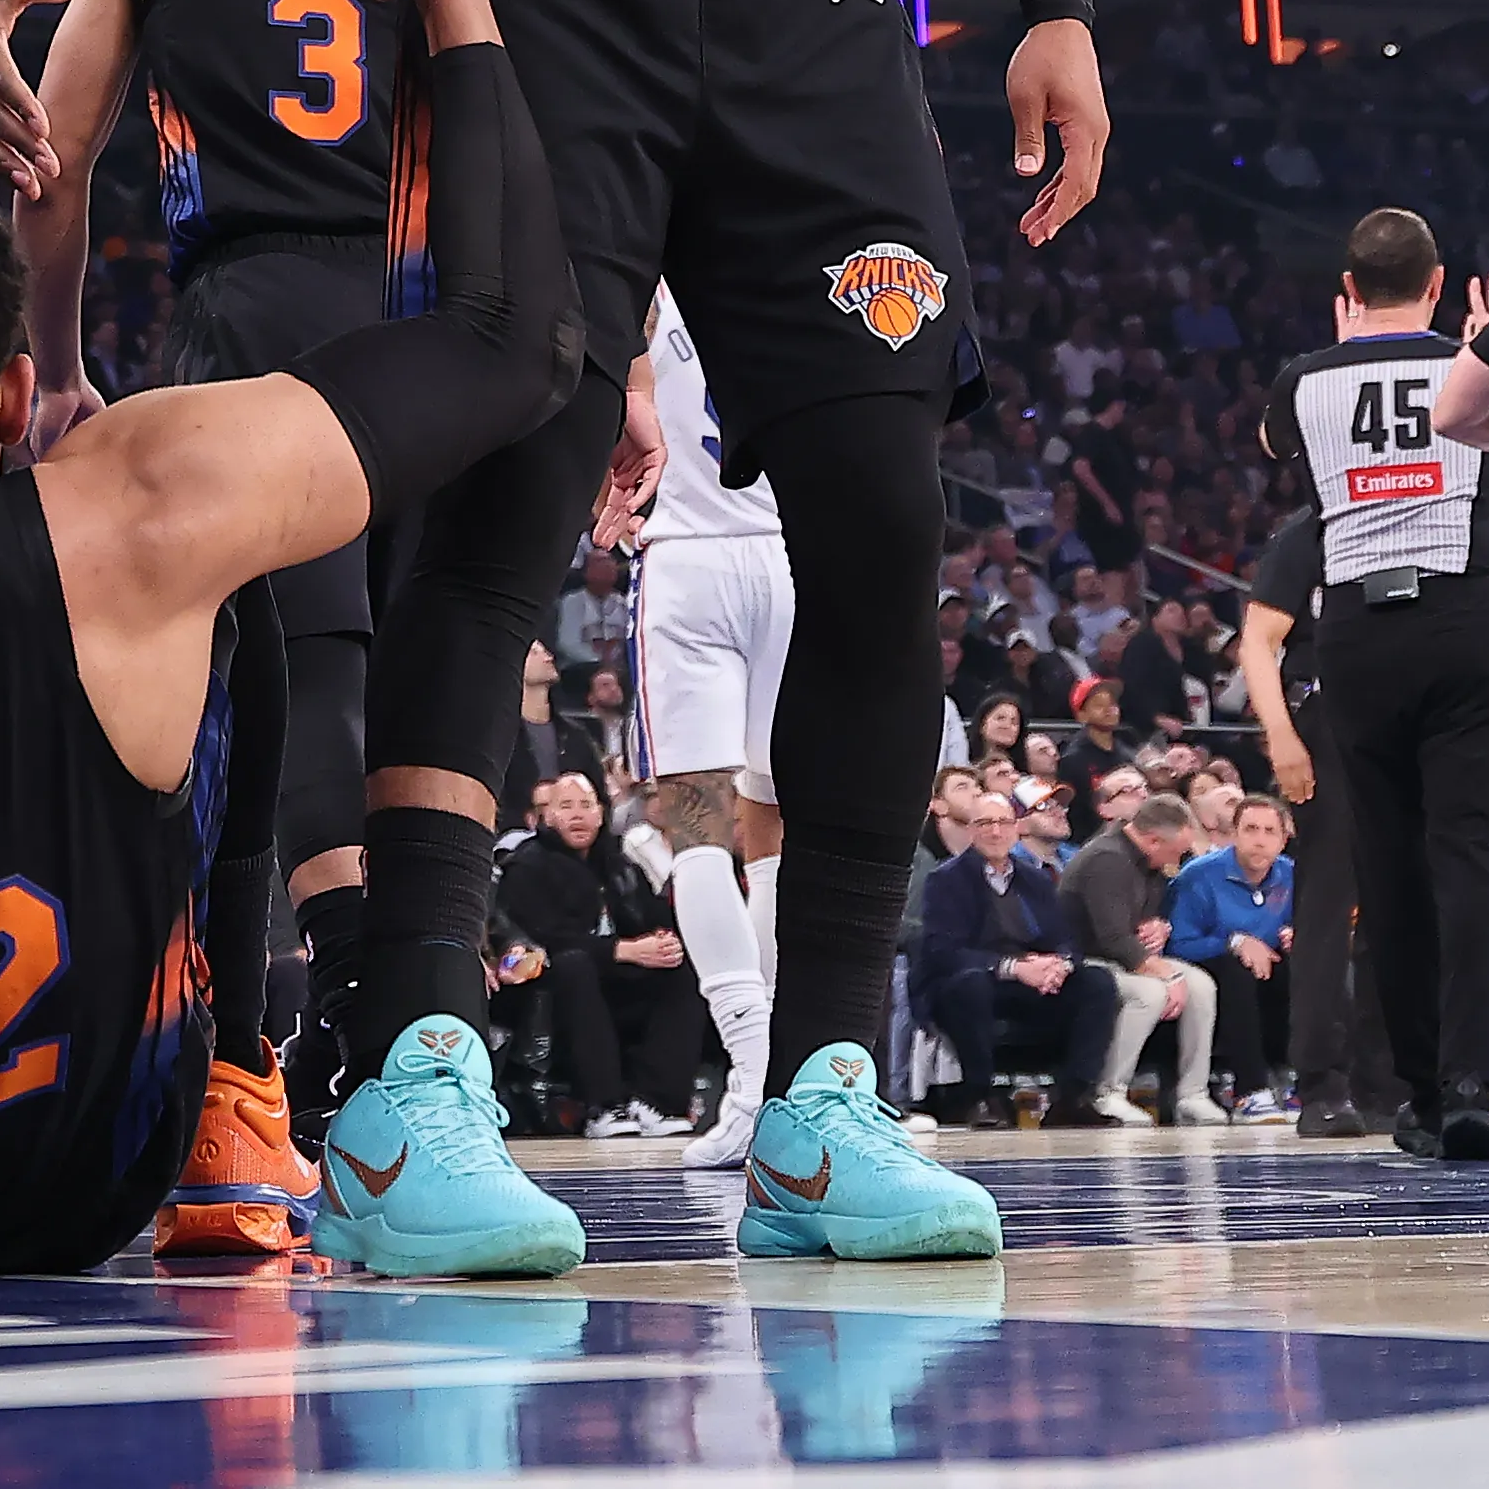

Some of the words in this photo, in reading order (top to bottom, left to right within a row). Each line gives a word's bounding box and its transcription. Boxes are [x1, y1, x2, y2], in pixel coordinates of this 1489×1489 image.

[834, 255, 942, 306] KNICKS
[1350, 378, 1432, 456] 45
[1354, 471, 1435, 495] Emirates
